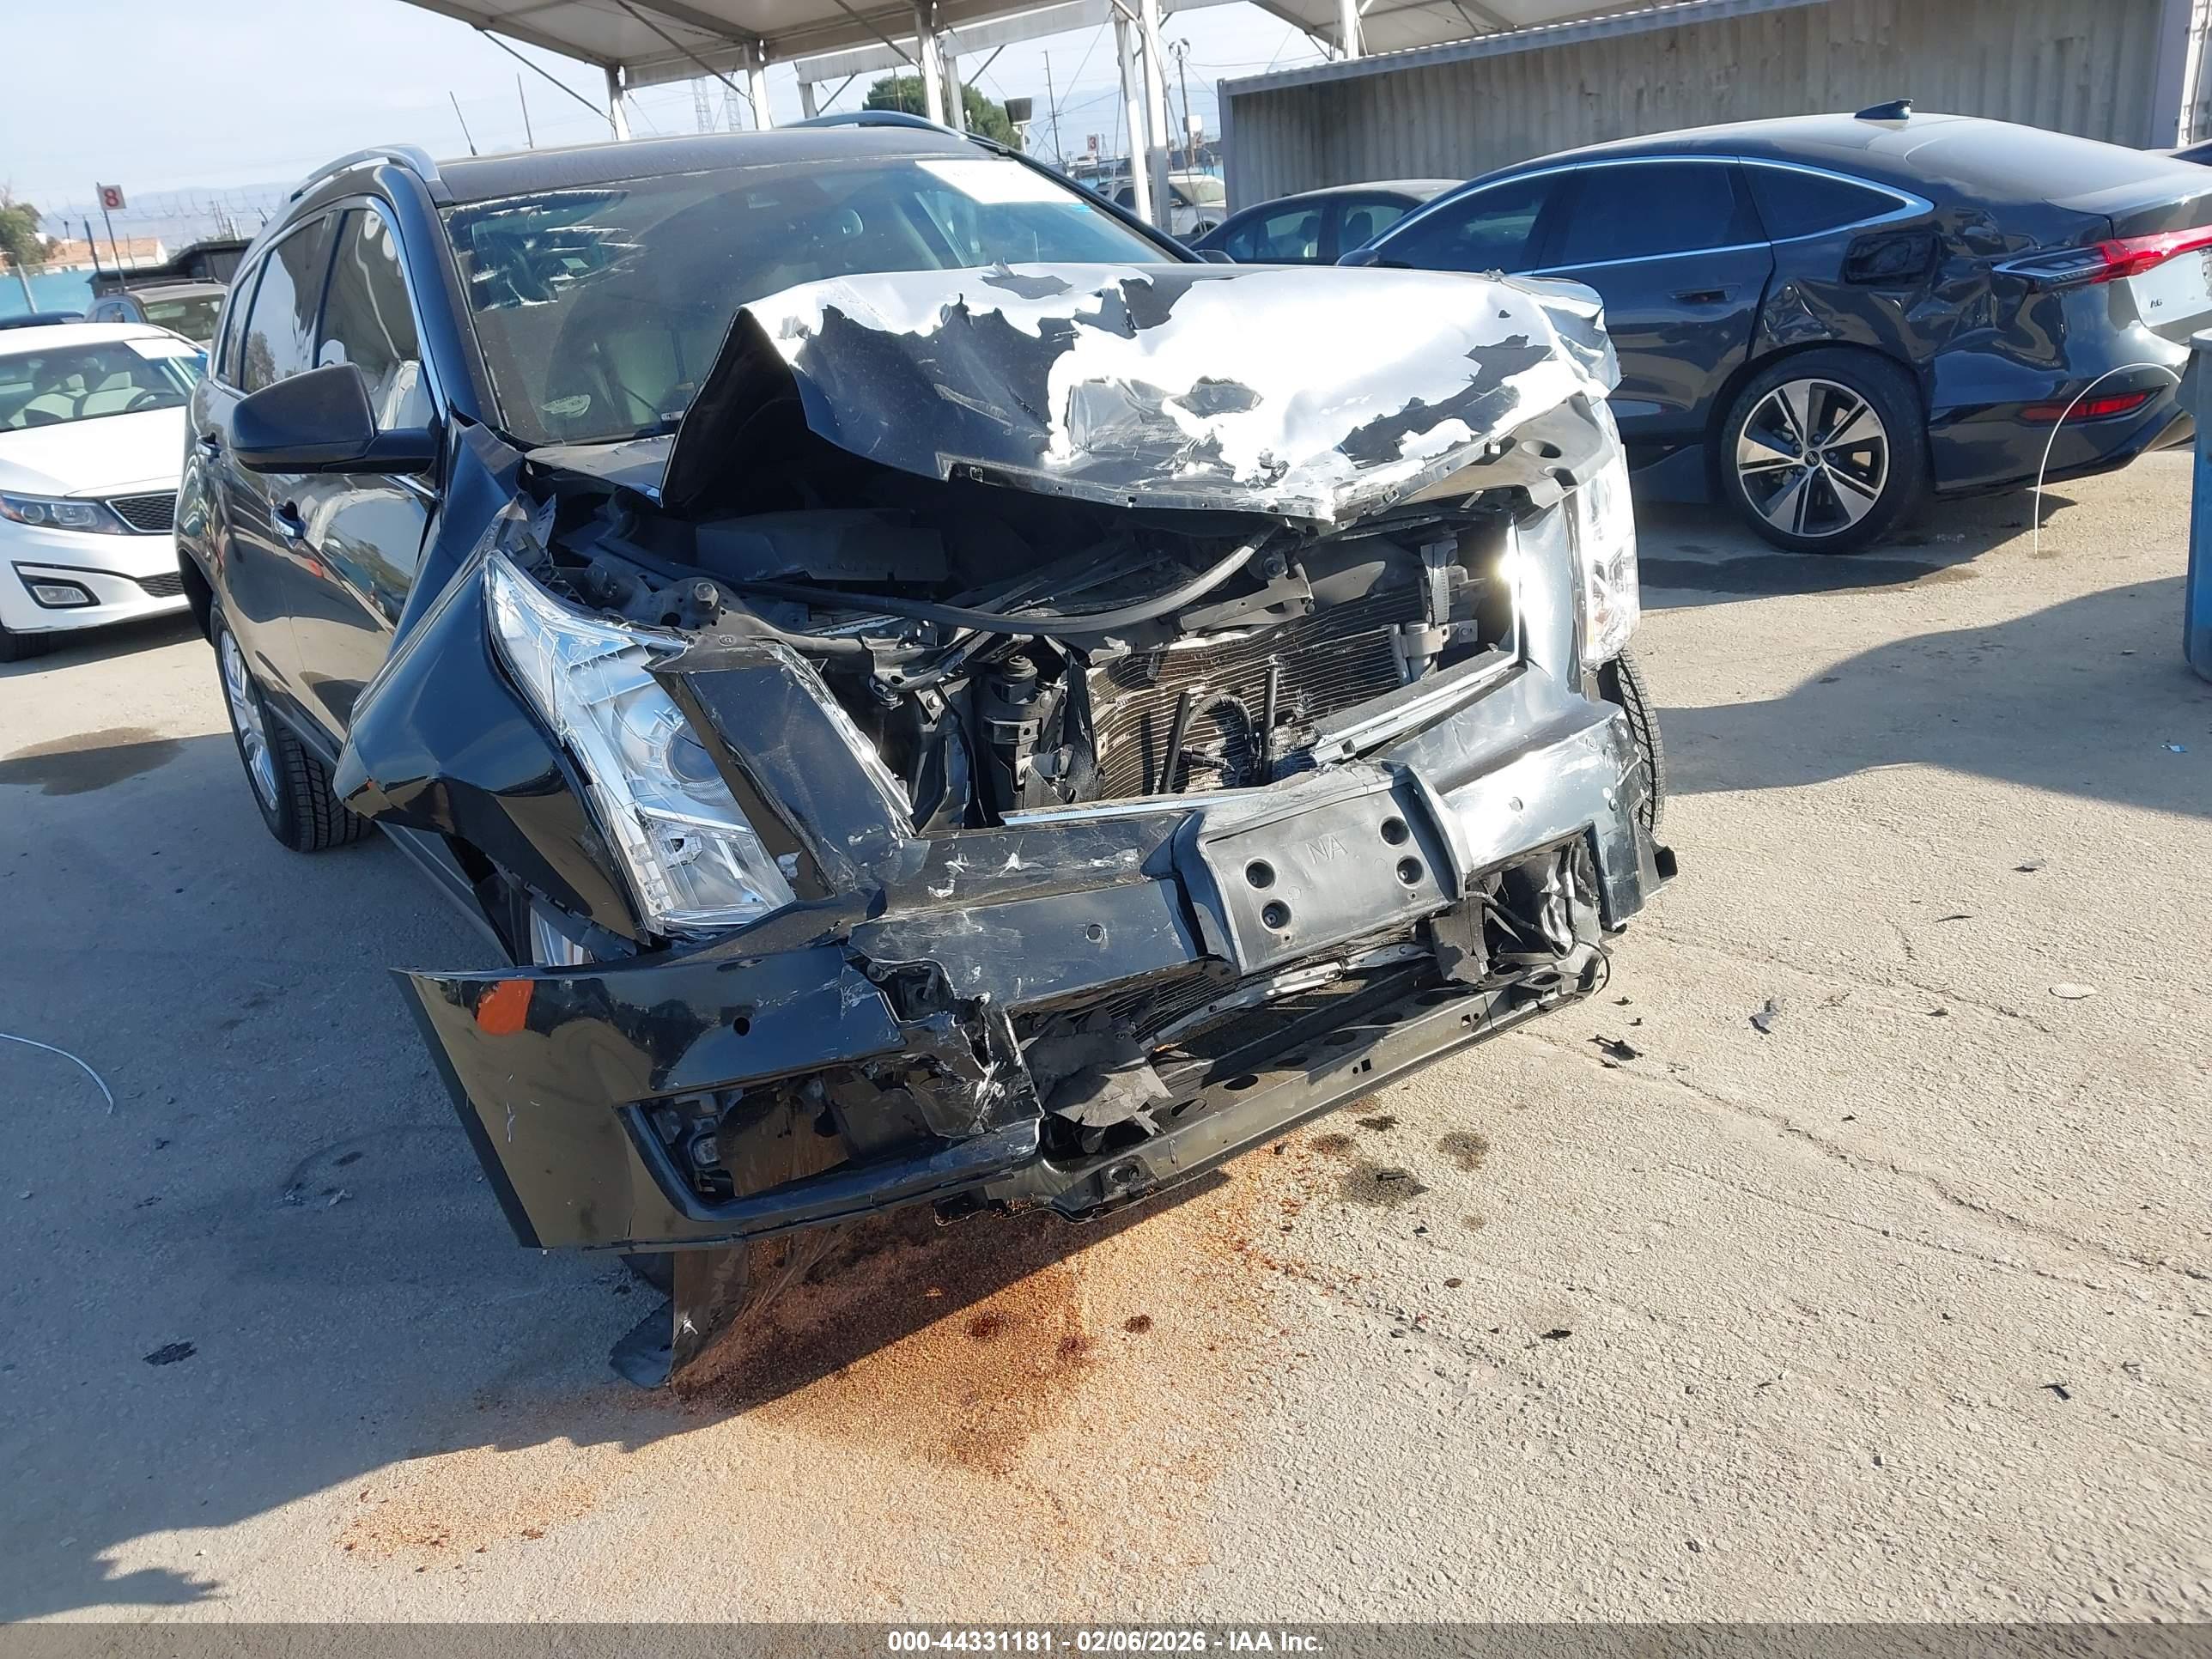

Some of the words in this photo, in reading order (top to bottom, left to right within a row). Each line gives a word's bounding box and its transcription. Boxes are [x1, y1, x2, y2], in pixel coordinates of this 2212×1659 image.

[1090, 137, 1097, 149] 3
[104, 188, 119, 207] 8
[1305, 836, 1348, 865] NA
